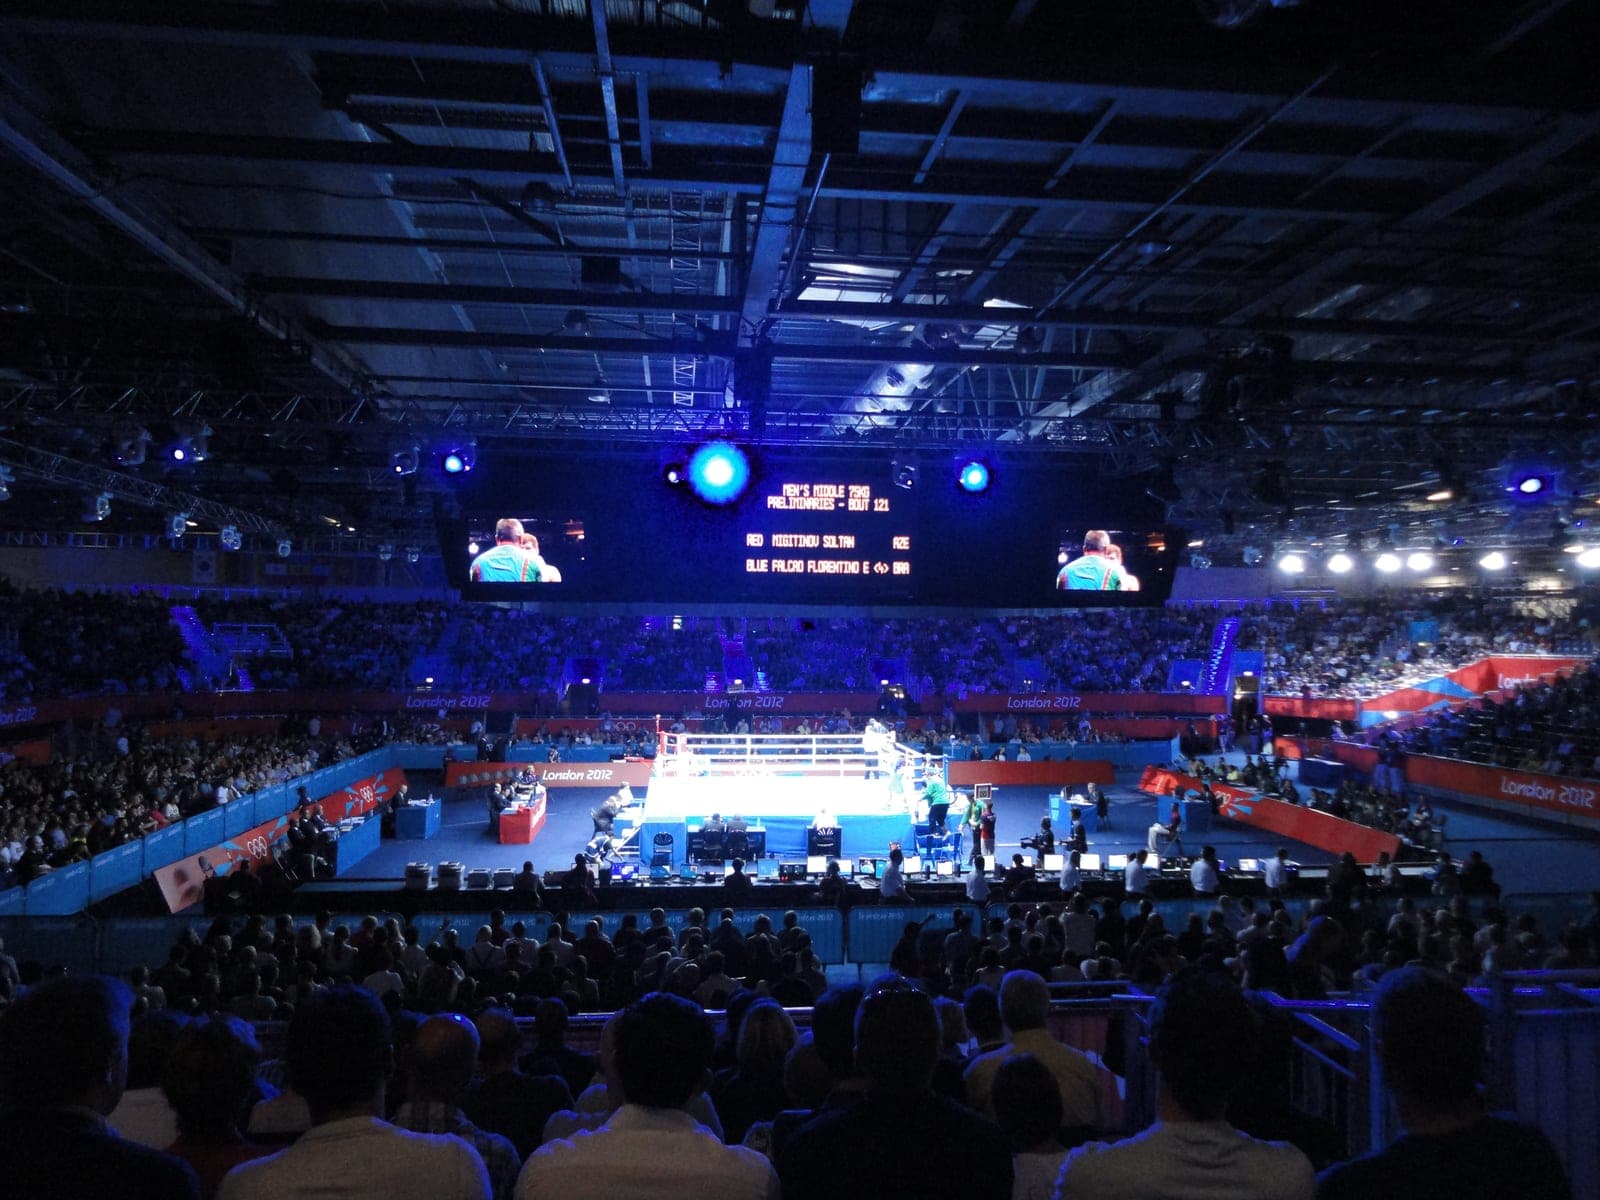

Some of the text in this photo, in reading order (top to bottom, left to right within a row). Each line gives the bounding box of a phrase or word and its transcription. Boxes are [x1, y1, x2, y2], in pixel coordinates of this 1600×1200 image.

[783, 484, 810, 497] MEN'S
[813, 485, 845, 498] MIDDLE
[767, 496, 835, 510] PRELIMINARIES
[848, 498, 869, 511] BOUT
[874, 499, 889, 511] 121
[746, 533, 764, 547] RED
[823, 535, 855, 548] SOLTAN
[892, 536, 910, 550] AZE
[746, 559, 769, 572] BLUE
[772, 560, 804, 573] FALCAO
[807, 560, 859, 574] FLORENTINO
[863, 561, 869, 574] E
[892, 562, 910, 575] BRA
[406, 696, 491, 708] London 2012
[755, 696, 784, 708] 2012
[1007, 697, 1081, 708] London 2012
[542, 769, 613, 780] London 2012
[1500, 776, 1596, 809] London 2012
